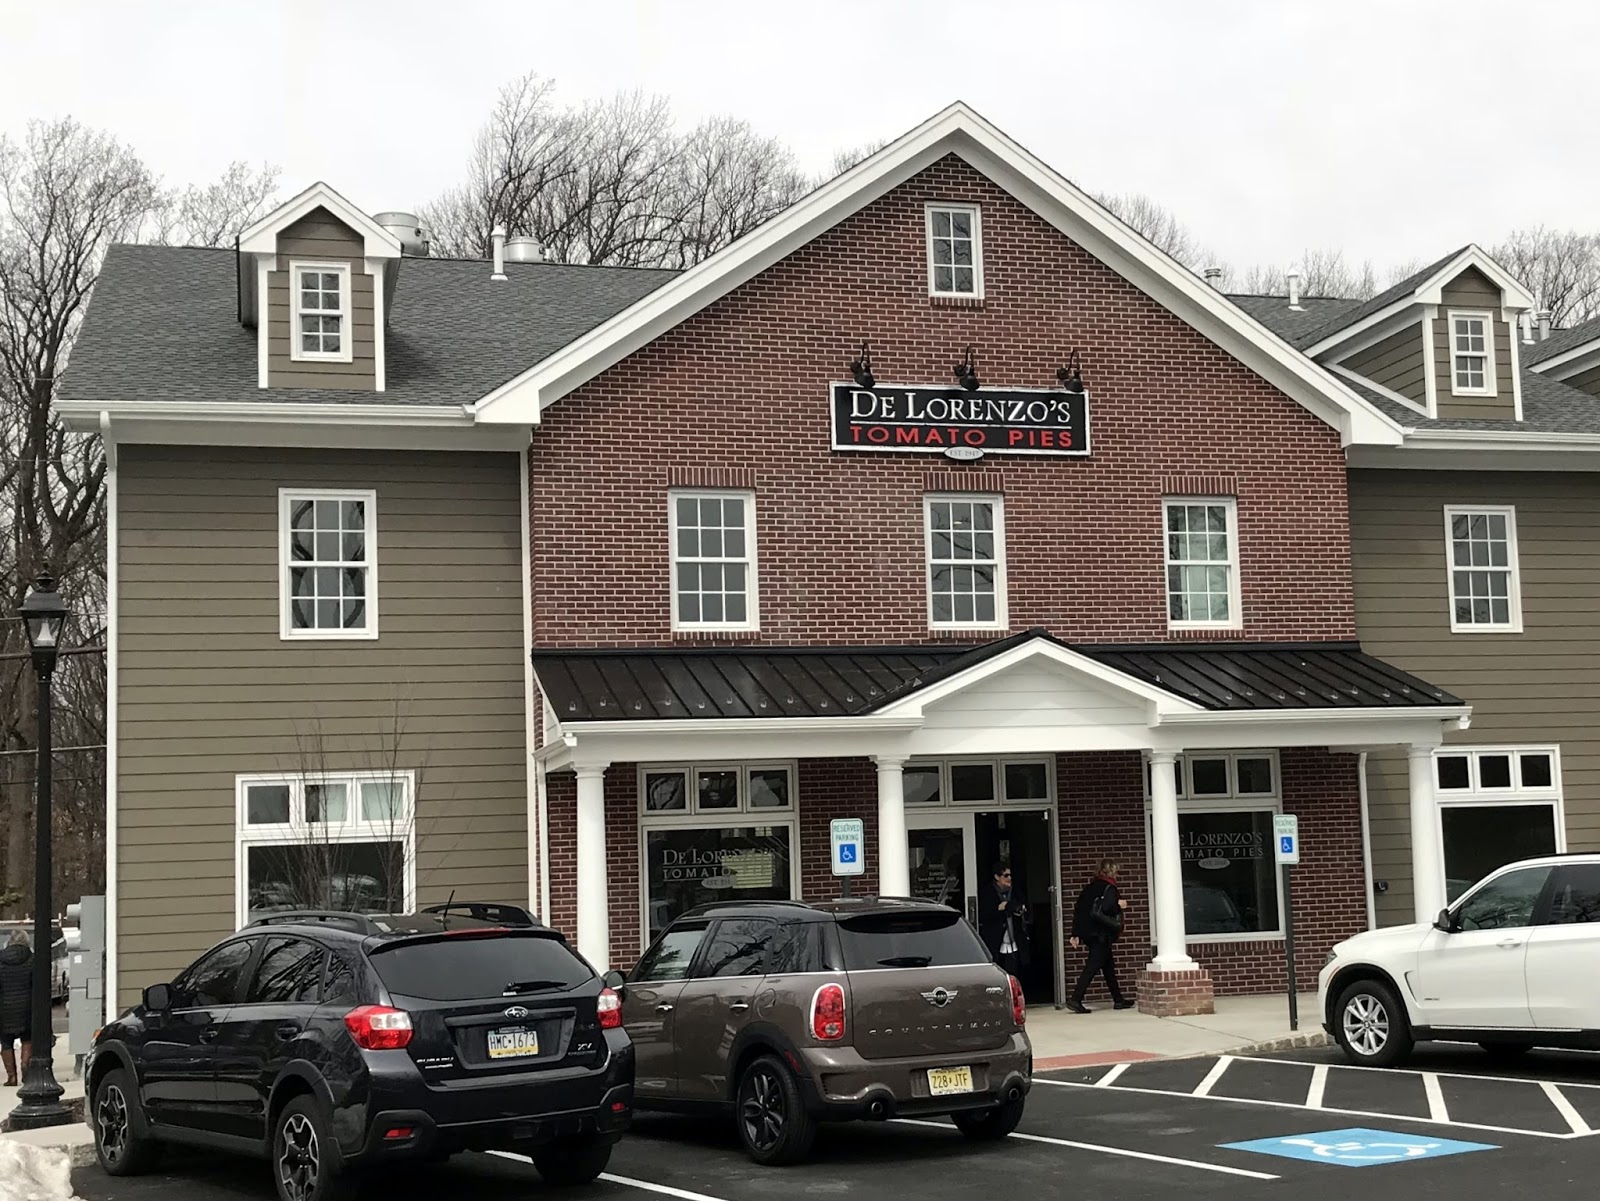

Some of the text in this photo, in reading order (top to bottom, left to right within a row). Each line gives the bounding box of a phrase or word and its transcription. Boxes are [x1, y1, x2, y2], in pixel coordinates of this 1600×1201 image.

[849, 390, 1071, 423] DE LORENZO'S
[850, 426, 1072, 448] TOMATO PIES
[835, 833, 859, 841] PARKING
[1189, 831, 1263, 846] LORENZO'S
[662, 849, 686, 865] DE
[1184, 846, 1264, 859] MATO PIES
[662, 867, 731, 880] TOMATO
